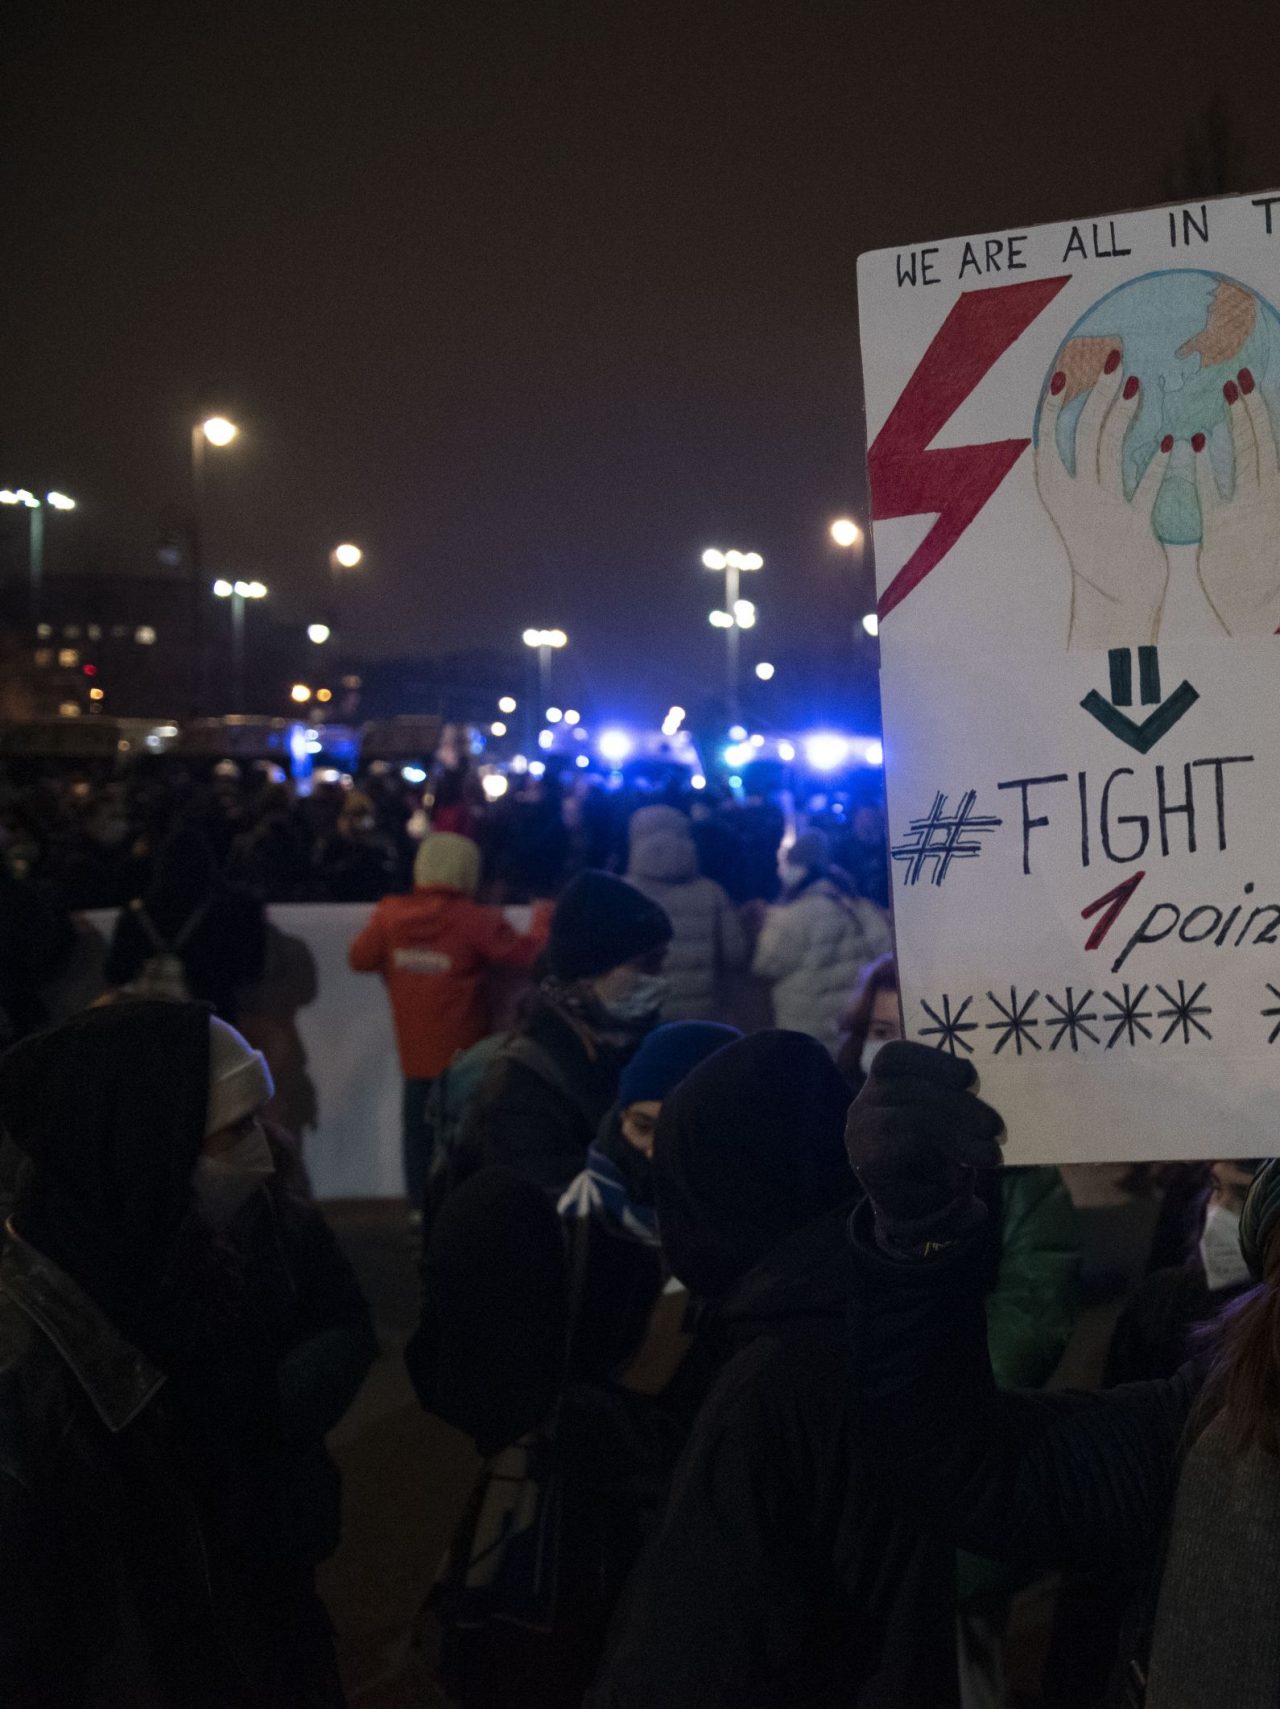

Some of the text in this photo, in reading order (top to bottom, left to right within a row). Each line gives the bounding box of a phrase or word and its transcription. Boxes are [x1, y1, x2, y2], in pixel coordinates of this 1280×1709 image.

[895, 246, 941, 289] WE
[957, 235, 1030, 281] ARE
[1062, 222, 1132, 263] ALL
[1168, 203, 1209, 248] IN
